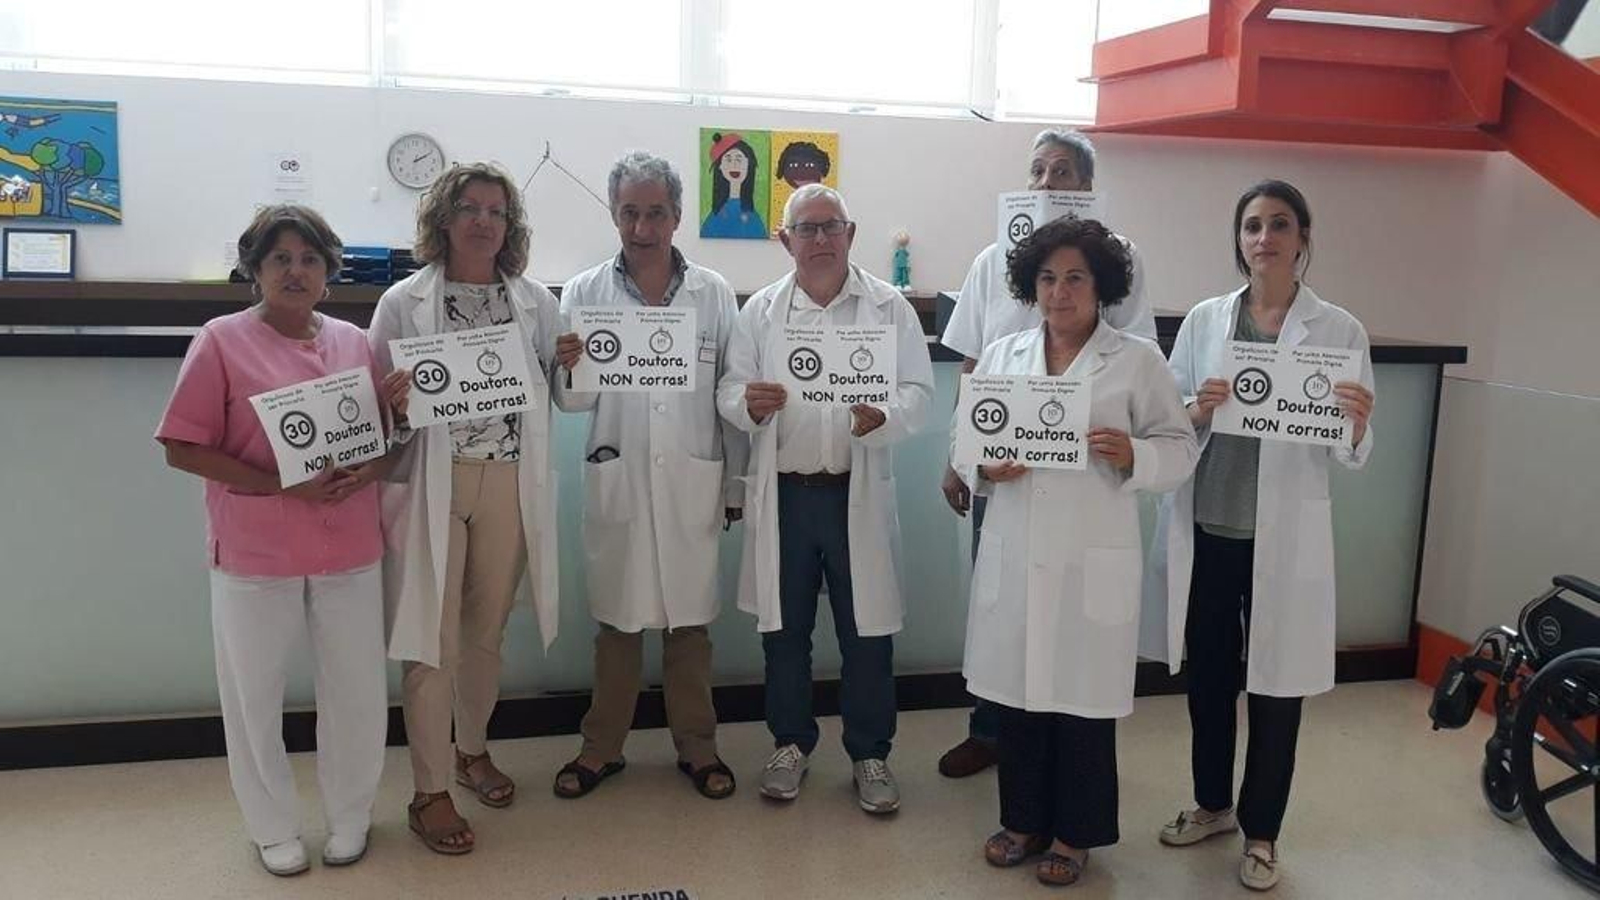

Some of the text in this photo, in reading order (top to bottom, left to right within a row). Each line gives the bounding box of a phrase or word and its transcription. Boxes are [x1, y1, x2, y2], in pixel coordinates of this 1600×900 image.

[1012, 222, 1030, 237] 30
[591, 339, 616, 354] 30
[628, 355, 688, 368] Doutora,
[794, 357, 817, 371] 30
[418, 368, 444, 385] 30
[459, 376, 523, 393] Doutora,
[599, 373, 688, 386] NON corras!
[829, 372, 889, 385] Doutora,
[1239, 378, 1266, 395] 30
[433, 393, 527, 418] NON corras!
[802, 391, 889, 404] NON corras!
[977, 408, 1003, 424] 30
[1277, 399, 1345, 420] Doutora,
[285, 419, 310, 440] 30
[324, 421, 376, 444] Doutora,
[1015, 426, 1079, 443] Doutora,
[1242, 416, 1343, 440] NON corras!
[338, 438, 379, 462] corras!
[983, 446, 1079, 463] NON corras!
